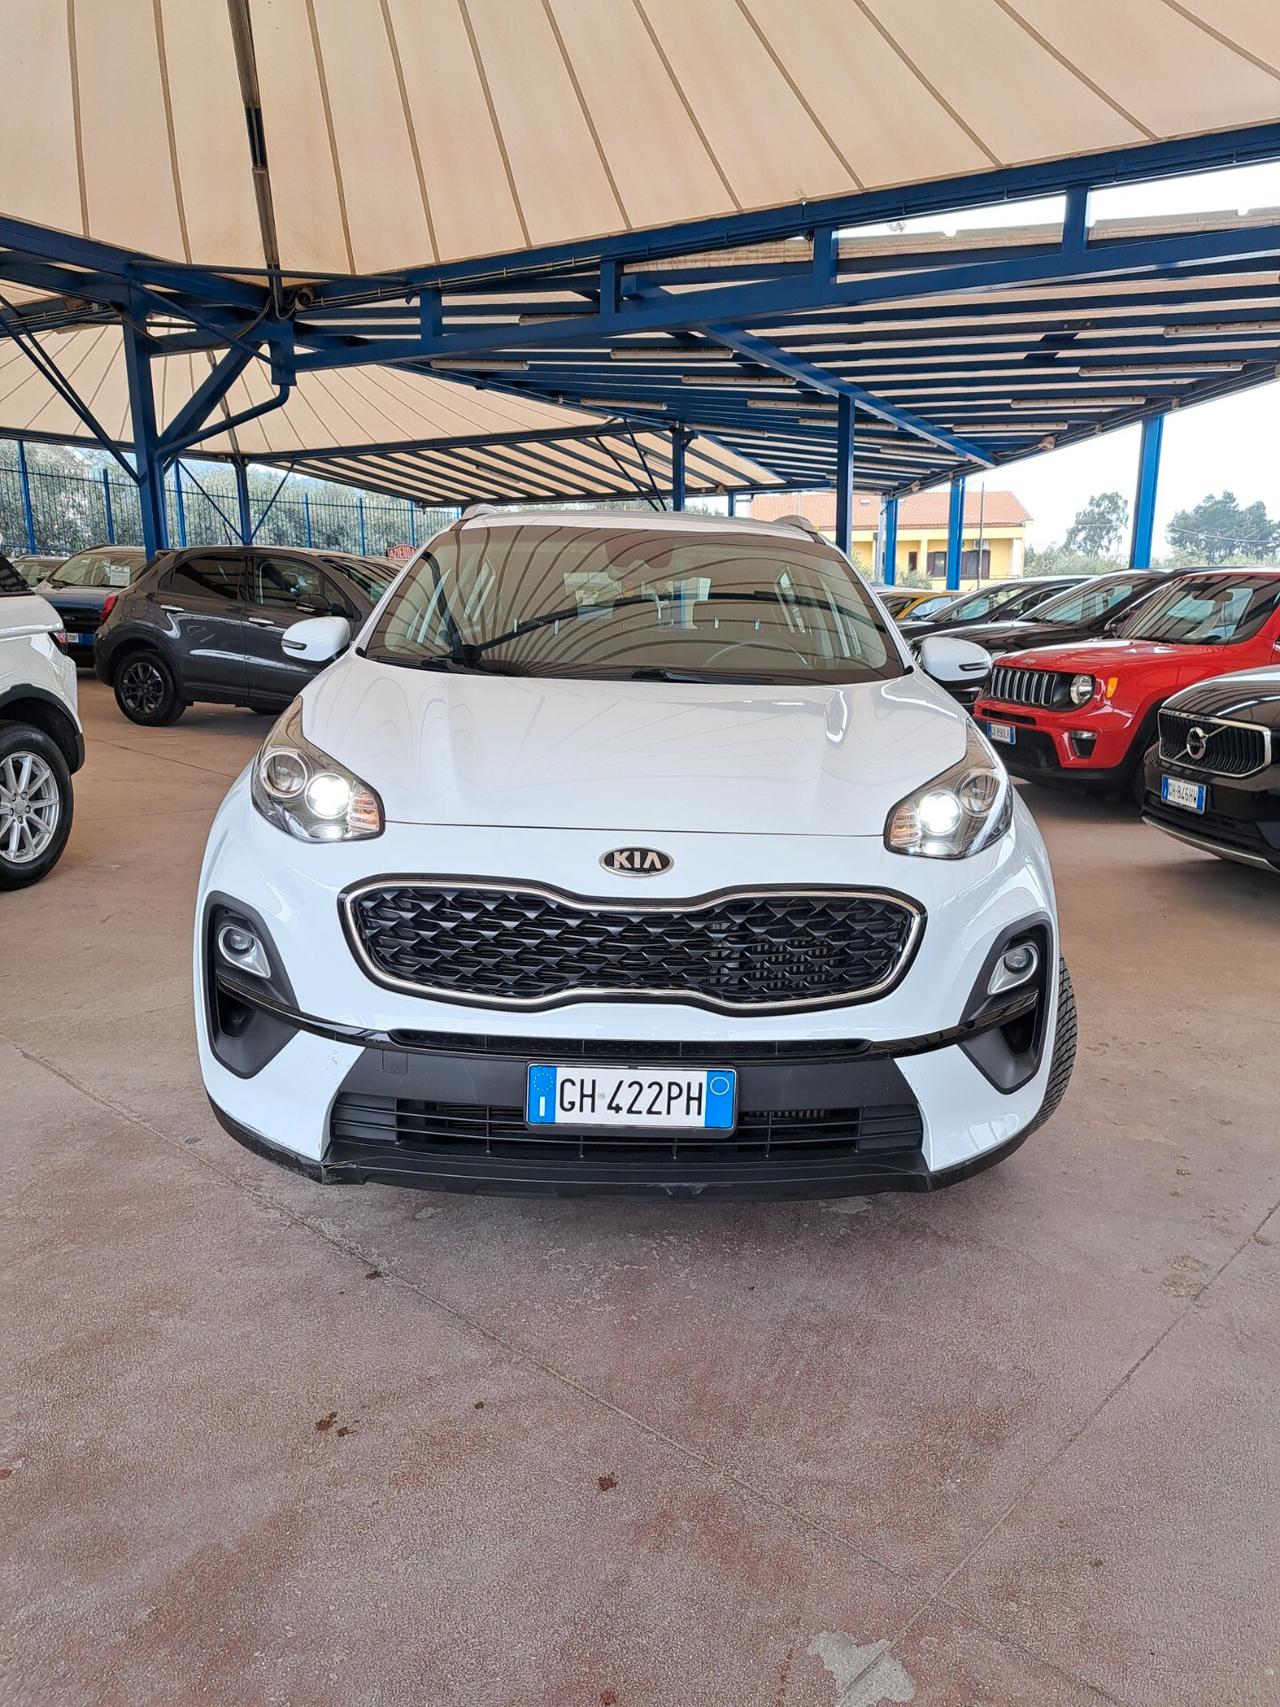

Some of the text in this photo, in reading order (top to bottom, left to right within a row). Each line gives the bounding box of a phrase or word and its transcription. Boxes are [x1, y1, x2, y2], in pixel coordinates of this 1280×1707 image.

[613, 851, 662, 869] KIA
[559, 1078, 596, 1113] GH
[607, 1080, 703, 1116] 422PH
